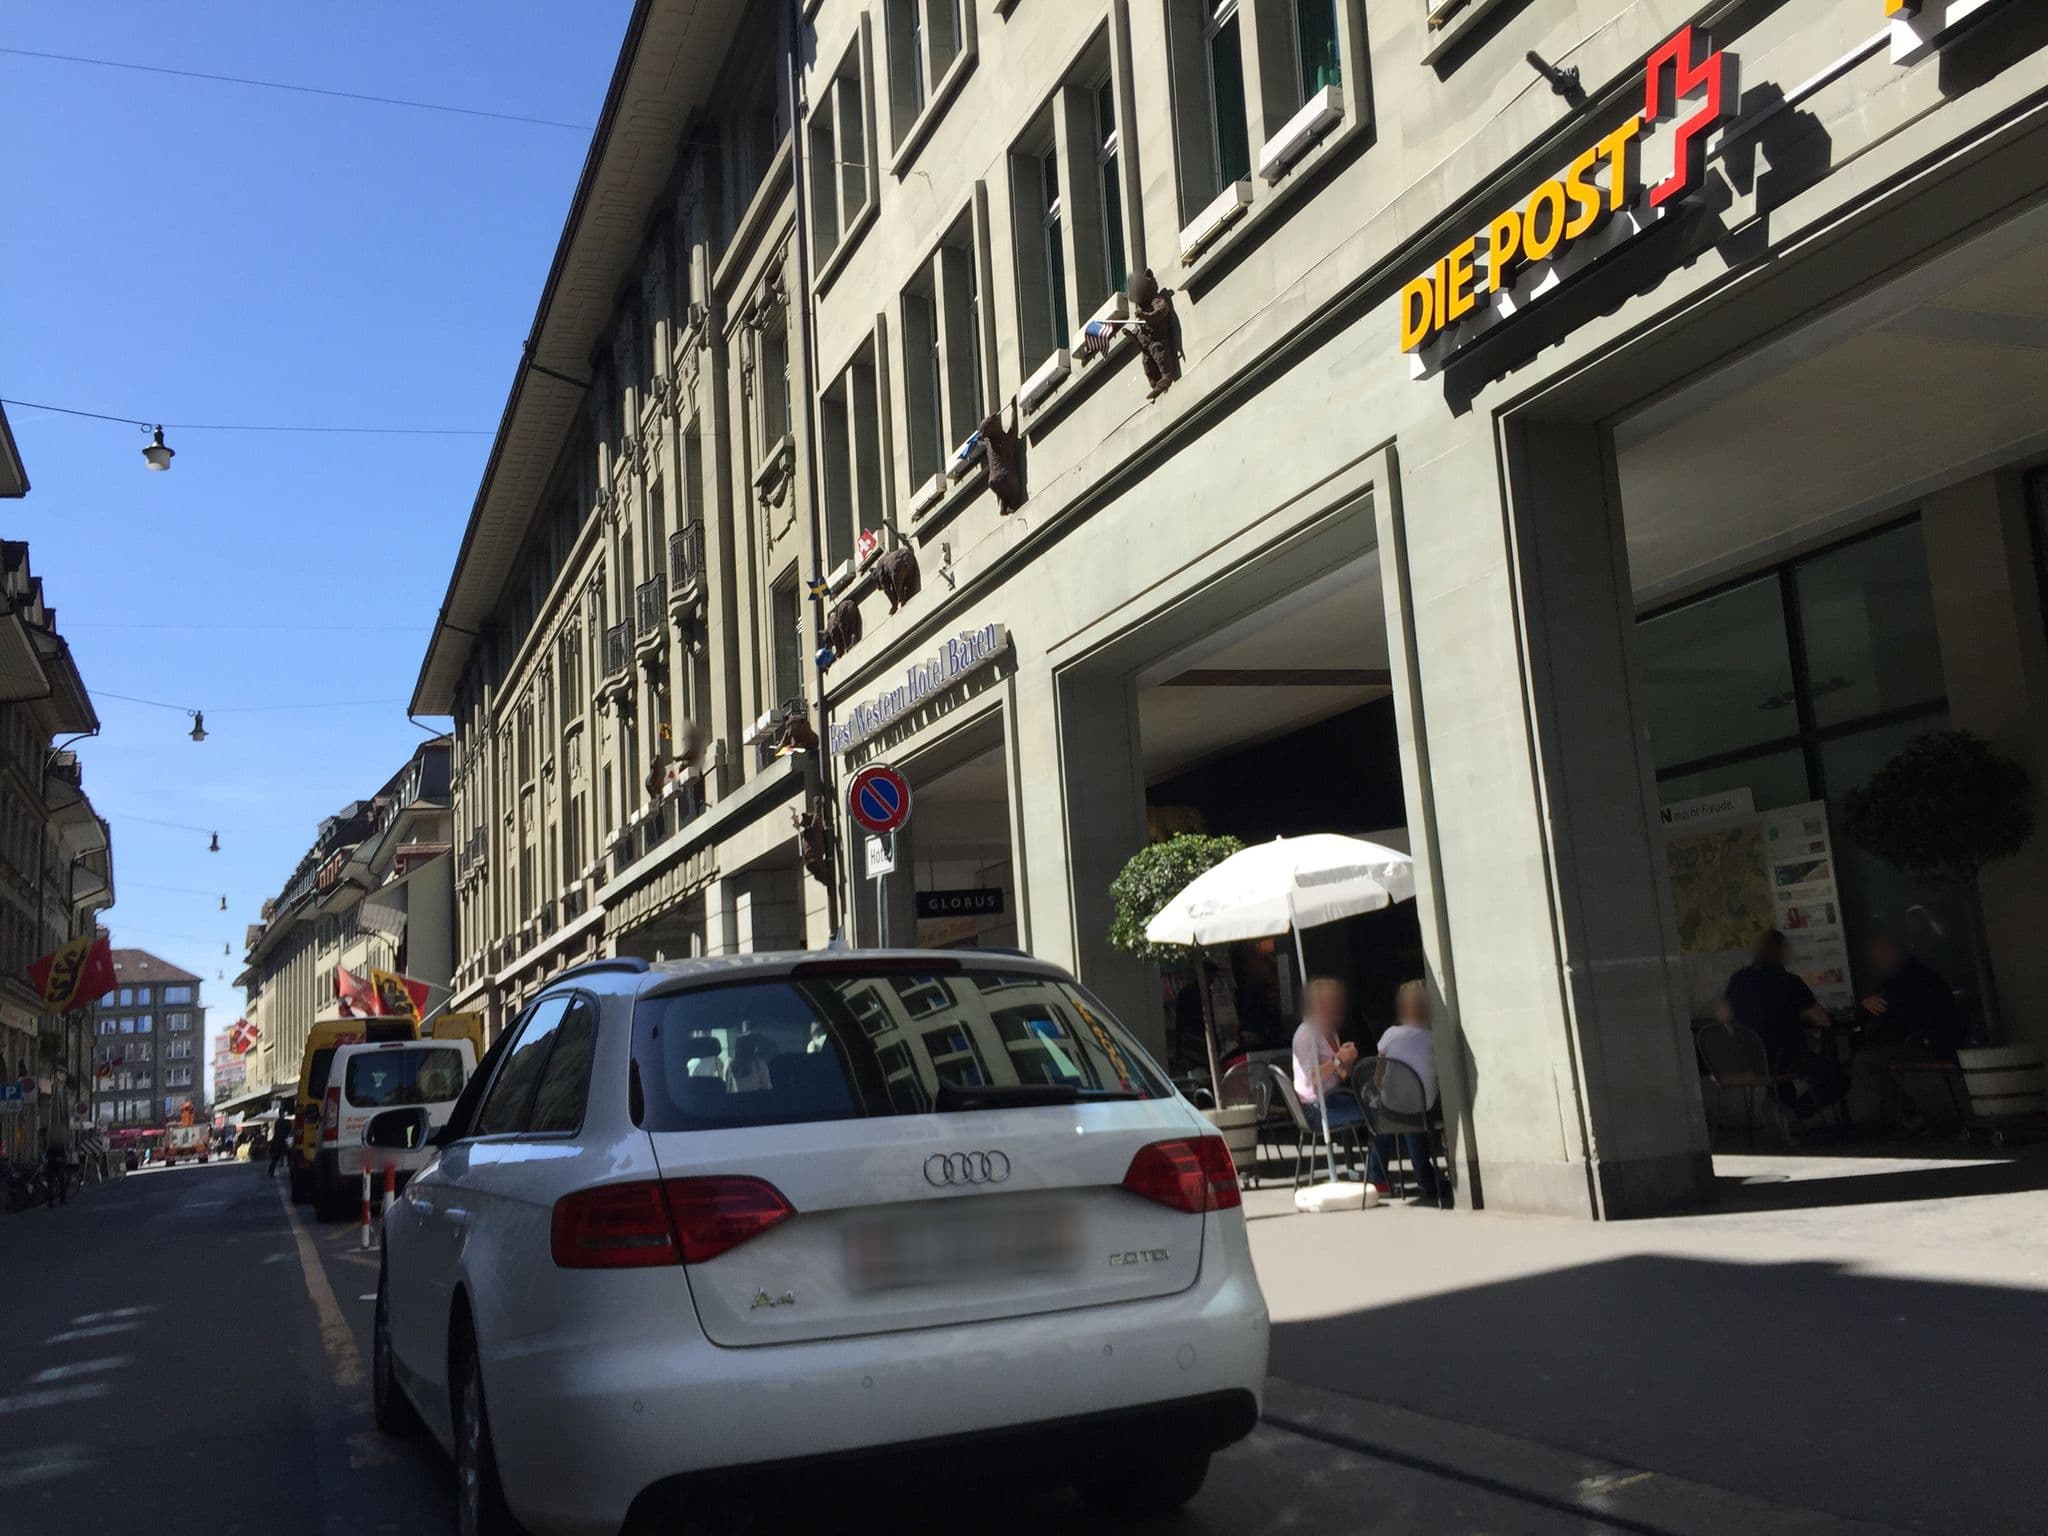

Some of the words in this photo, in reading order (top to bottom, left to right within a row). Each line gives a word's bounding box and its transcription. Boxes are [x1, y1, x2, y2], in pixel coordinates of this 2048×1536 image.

[1400, 235, 1475, 353] DIE
[1489, 116, 1639, 293] POST
[829, 718, 854, 755] Best
[854, 685, 906, 737] Western
[907, 647, 946, 702] Hotel
[947, 623, 997, 677] Bären
[928, 896, 995, 910] GLOBUS
